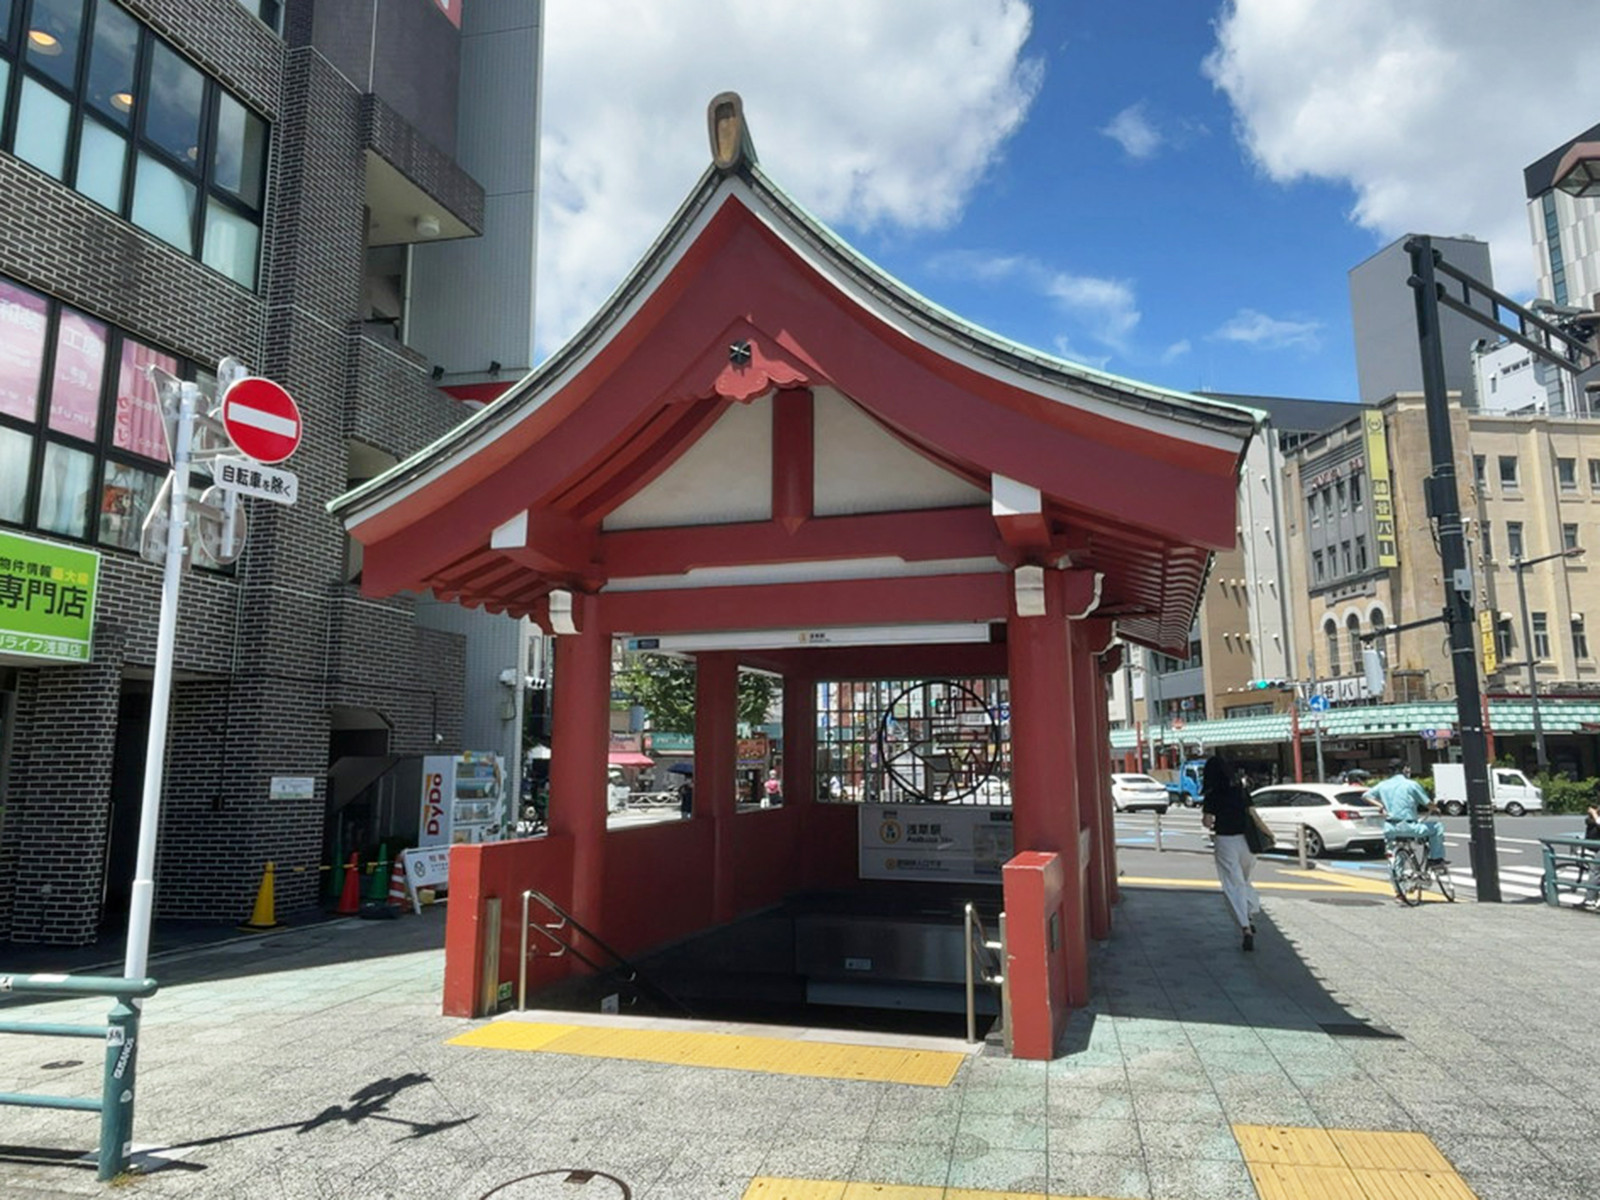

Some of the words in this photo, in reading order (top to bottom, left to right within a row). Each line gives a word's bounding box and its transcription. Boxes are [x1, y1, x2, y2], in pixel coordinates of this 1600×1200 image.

[222, 465, 291, 498] 自転車を除く
[426, 773, 444, 836] DyDo
